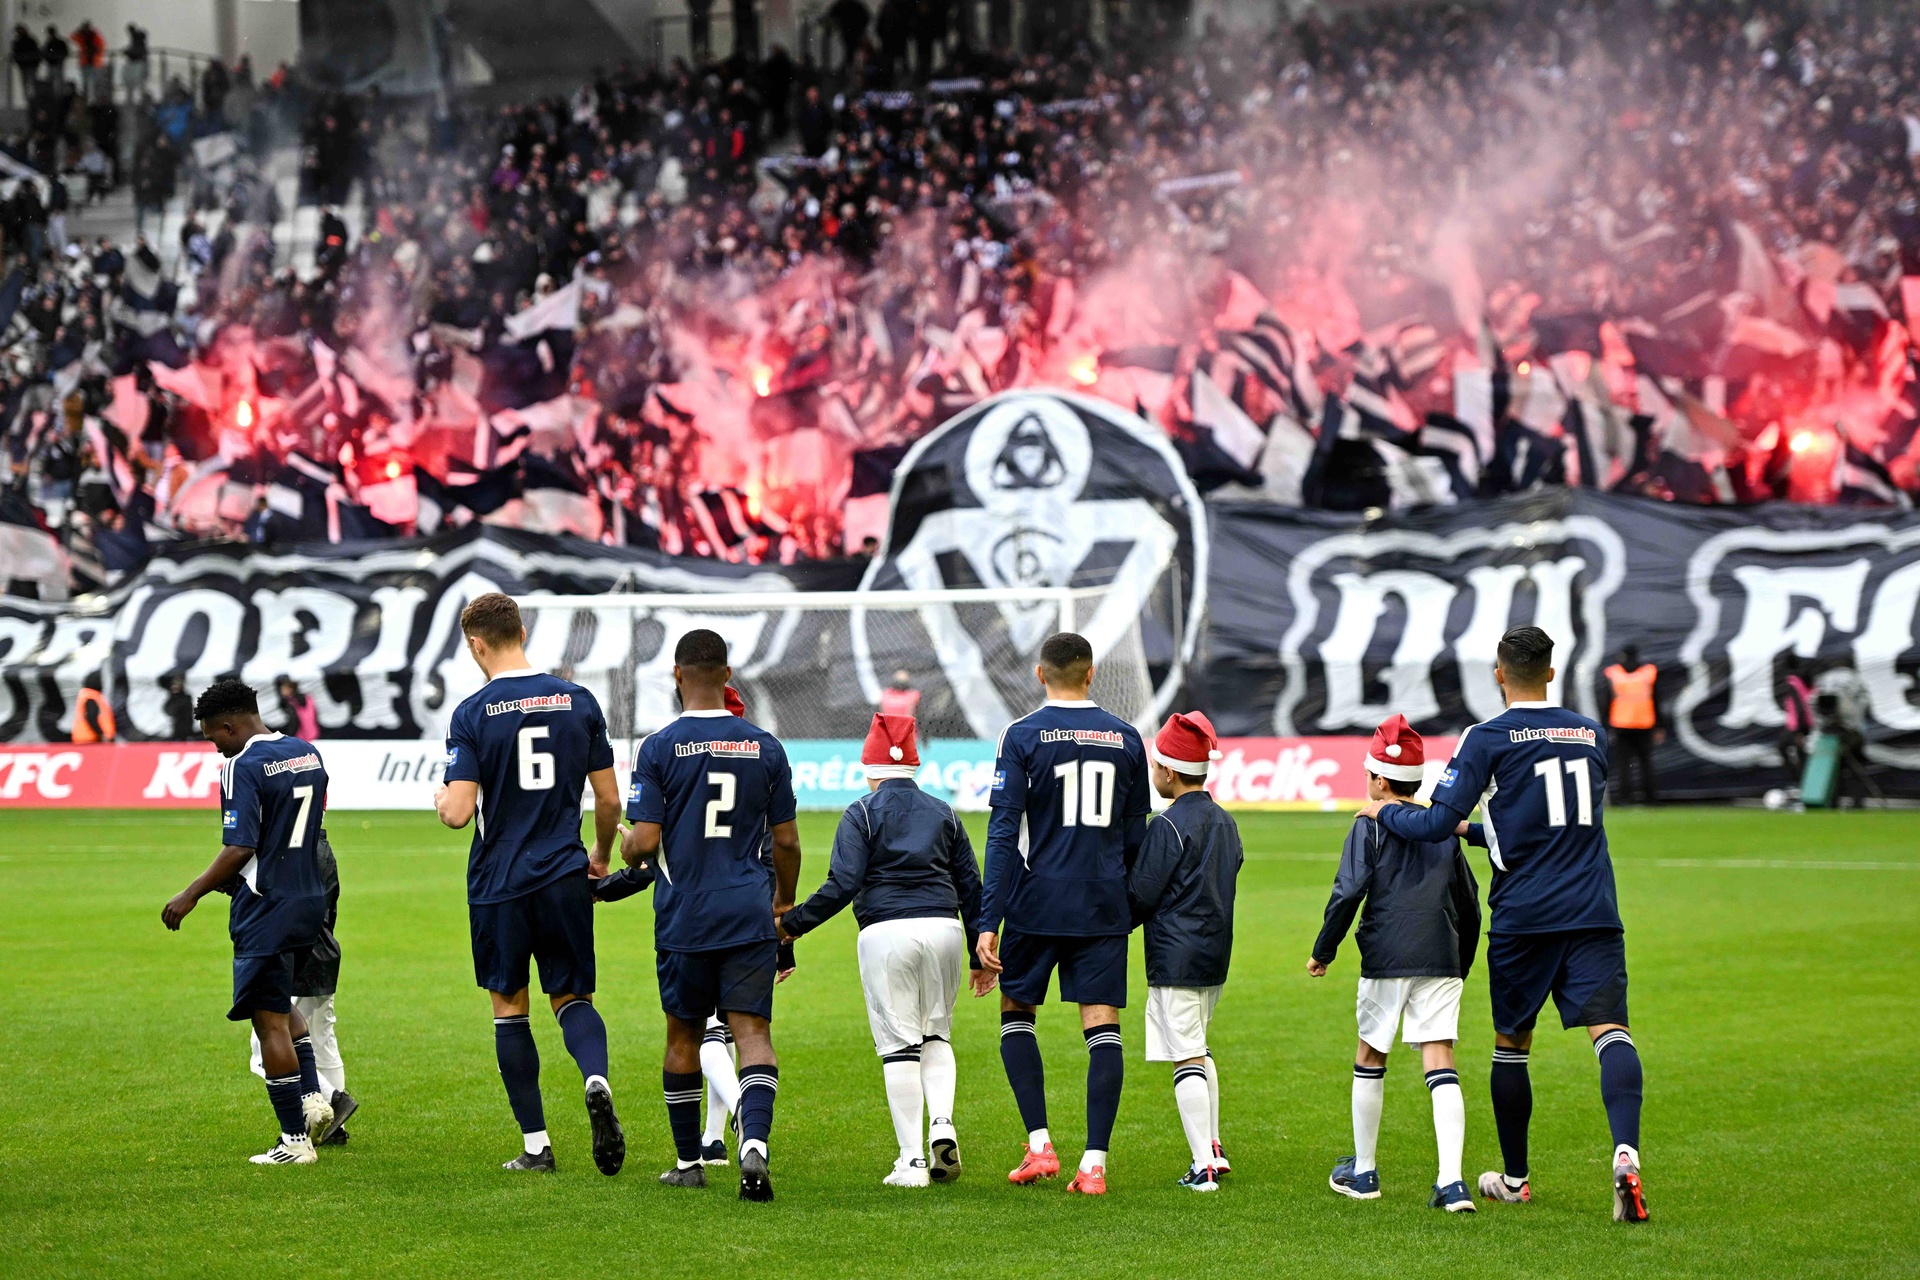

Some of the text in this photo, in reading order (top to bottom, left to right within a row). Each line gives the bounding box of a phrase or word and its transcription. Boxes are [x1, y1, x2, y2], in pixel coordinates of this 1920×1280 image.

[142, 751, 224, 799] KF
[376, 751, 448, 783] Inte
[518, 726, 556, 790] 6
[792, 754, 873, 792] RÉD
[288, 785, 314, 848] 7
[704, 772, 737, 839] 2
[1054, 759, 1116, 827] 10
[1534, 757, 1593, 827] 11
